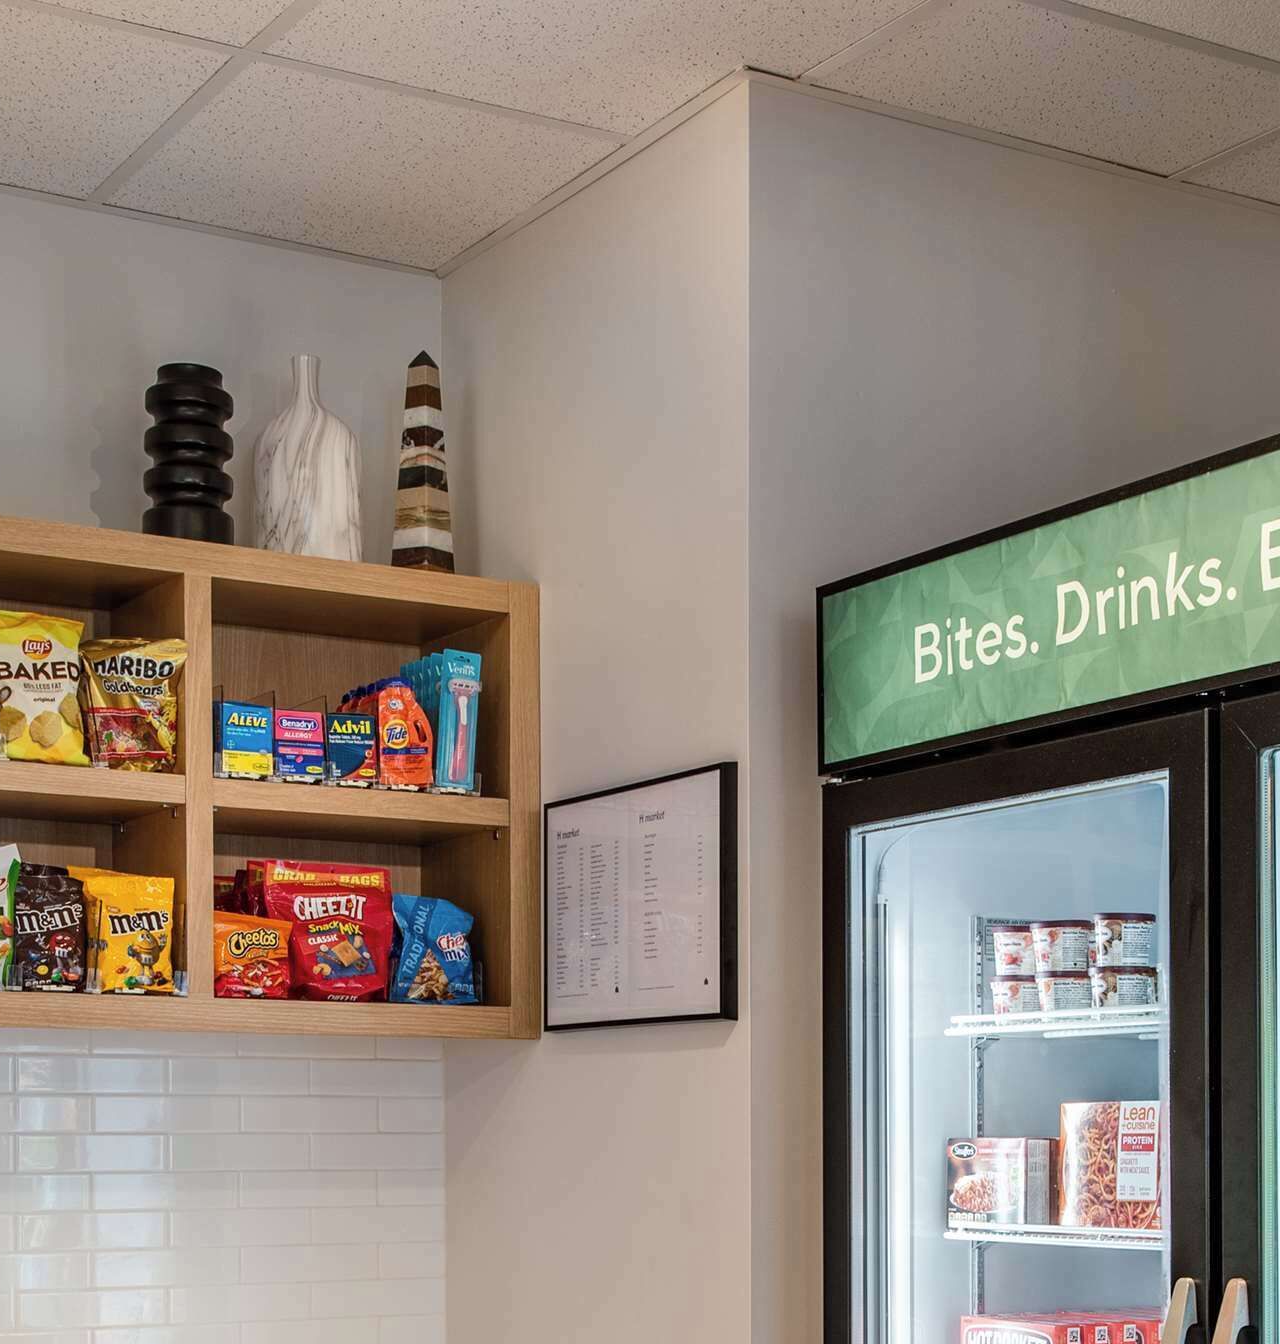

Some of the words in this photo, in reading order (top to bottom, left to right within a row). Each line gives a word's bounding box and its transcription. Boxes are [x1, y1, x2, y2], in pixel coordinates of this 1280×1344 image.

[914, 610, 1039, 684] Bites.
[1055, 551, 1238, 646] Drinks.
[24, 638, 51, 655] Lay's
[94, 656, 174, 680] HARIBO
[103, 679, 164, 695] Goldbears
[227, 712, 268, 728] ALEVE
[282, 718, 315, 730] Benadryl
[330, 719, 371, 735] Advil
[283, 731, 312, 740] ALLERGY
[386, 726, 407, 744] Tide
[273, 870, 316, 881] GRAB
[339, 874, 380, 888] BAGS
[308, 920, 339, 933] Snack
[228, 930, 278, 957] Cheetos
[308, 934, 339, 946] CLASSIC
[1124, 1107, 1155, 1121] Lean
[1123, 1136, 1153, 1145] PROTEIN
